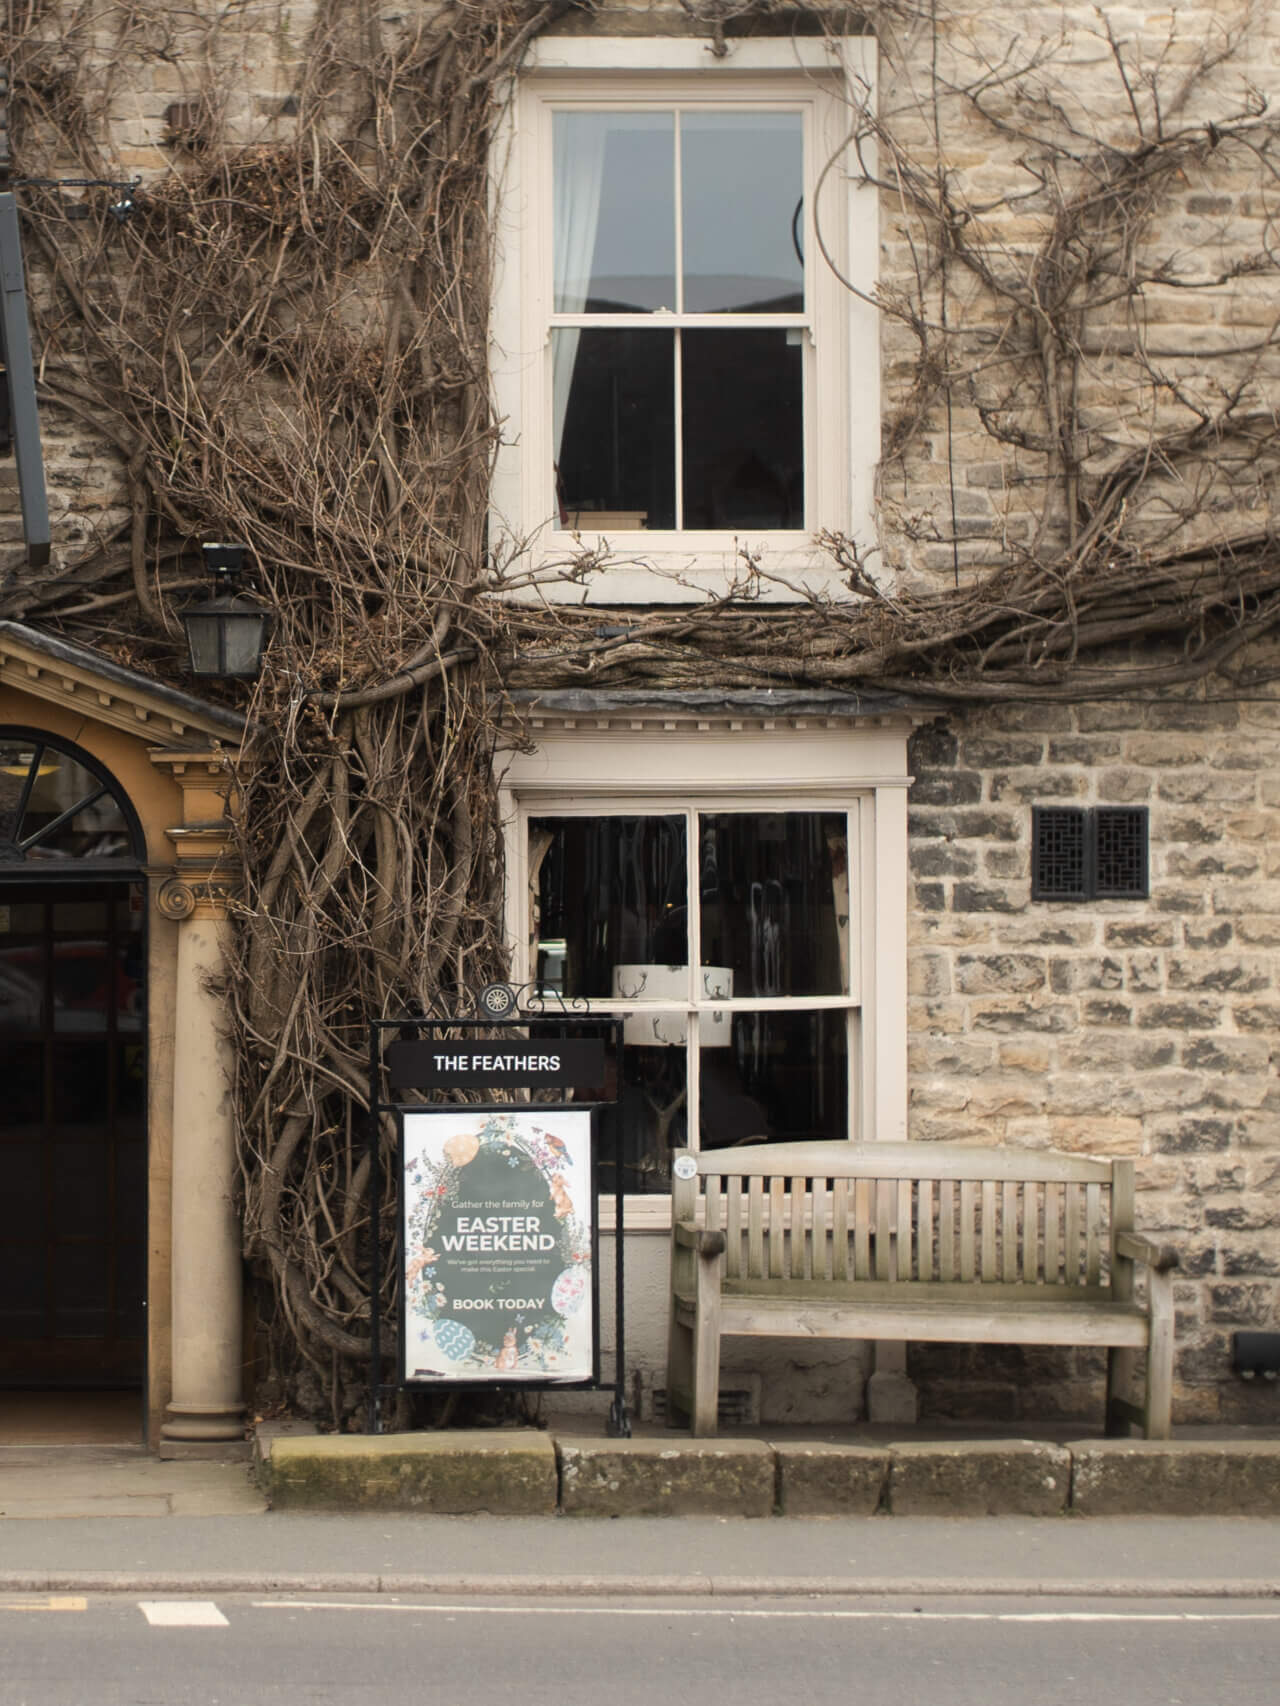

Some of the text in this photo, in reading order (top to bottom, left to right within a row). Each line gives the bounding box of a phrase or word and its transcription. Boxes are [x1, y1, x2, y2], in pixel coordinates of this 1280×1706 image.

[433, 1055, 561, 1071] THE FEATHERS
[451, 1200, 545, 1210] Gather the family for
[456, 1216, 541, 1233] EASTER
[441, 1234, 556, 1252] WEEKEND
[453, 1298, 545, 1310] BOOK TODAY
